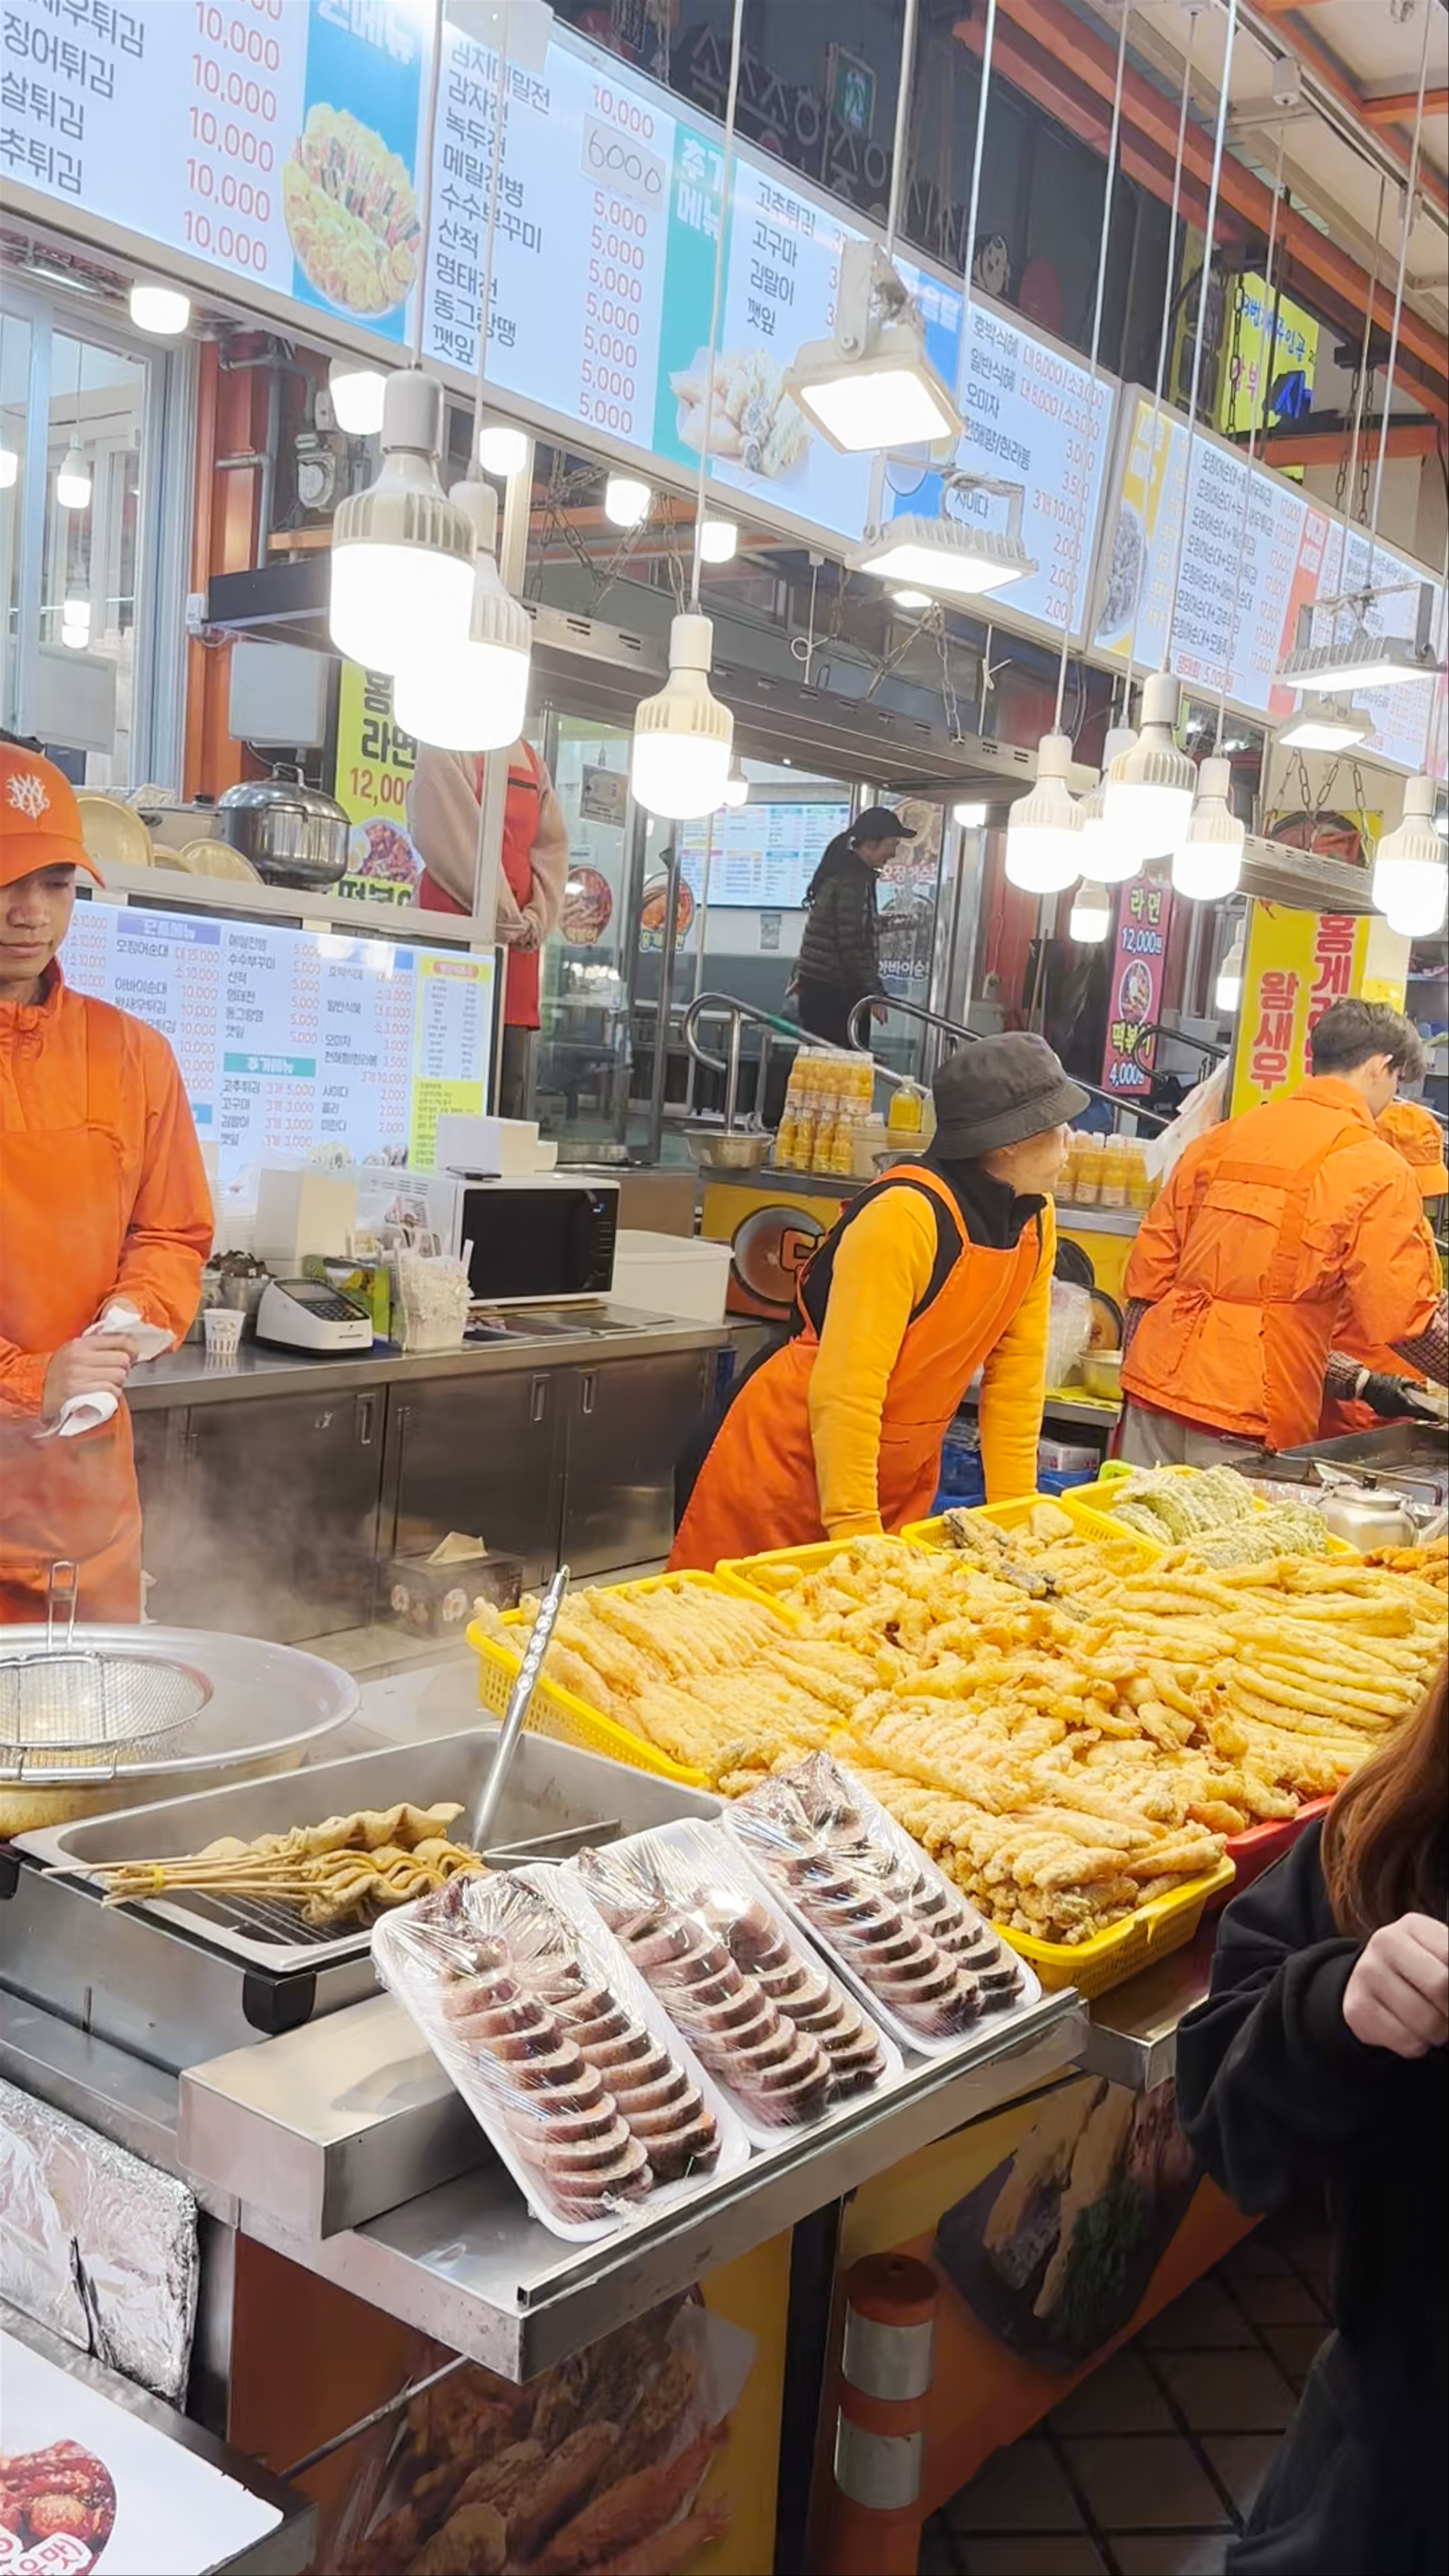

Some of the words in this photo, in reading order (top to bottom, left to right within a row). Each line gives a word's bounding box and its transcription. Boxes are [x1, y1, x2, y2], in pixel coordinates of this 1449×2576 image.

[196, 2, 279, 71] 10,000
[193, 54, 276, 121] 10,000
[593, 85, 654, 139] 10,000
[189, 107, 274, 172] 10,000
[589, 130, 661, 193] 6000
[187, 159, 270, 222] 10,000
[446, 107, 505, 163] 녹두전
[594, 191, 646, 238] 5,000
[443, 143, 523, 208] 메밀전병
[591, 225, 644, 270] 5,000
[677, 182, 719, 240] 메뉴
[757, 181, 815, 237] 고추튀김
[183, 211, 267, 272] 10,000
[753, 220, 797, 267] 고구마
[439, 218, 478, 259] 산적
[587, 292, 639, 336] 5,000
[589, 258, 642, 302] 5,000
[751, 258, 794, 305] 김말이
[437, 254, 498, 304] 명태전
[585, 326, 637, 368] 5,000
[747, 298, 775, 336] 깻잎
[434, 289, 515, 347] 동그랑땡
[582, 359, 634, 401] 5,000
[434, 325, 474, 366] 깻잎
[579, 392, 632, 433] 5,000
[967, 383, 999, 419] 오미자
[955, 491, 989, 519] 사이다
[362, 719, 415, 769] 라면
[1130, 888, 1161, 924] 라면
[228, 971, 247, 984] 산적
[292, 980, 320, 993] 5,000
[293, 962, 320, 976] 5,000
[880, 960, 929, 977] 아바이순
[182, 986, 218, 1000] 10,000
[182, 1004, 217, 1018] 10,000
[291, 997, 320, 1010] 5,000
[180, 1022, 216, 1036] 10,000
[290, 1015, 318, 1027] 5,000
[290, 1032, 317, 1044] 5,000
[181, 1040, 215, 1054] 10,000
[183, 1059, 214, 1073] 0,000
[380, 1106, 405, 1117] 2,000
[381, 1089, 405, 1101] 2,000
[379, 1122, 403, 1133] 2,000
